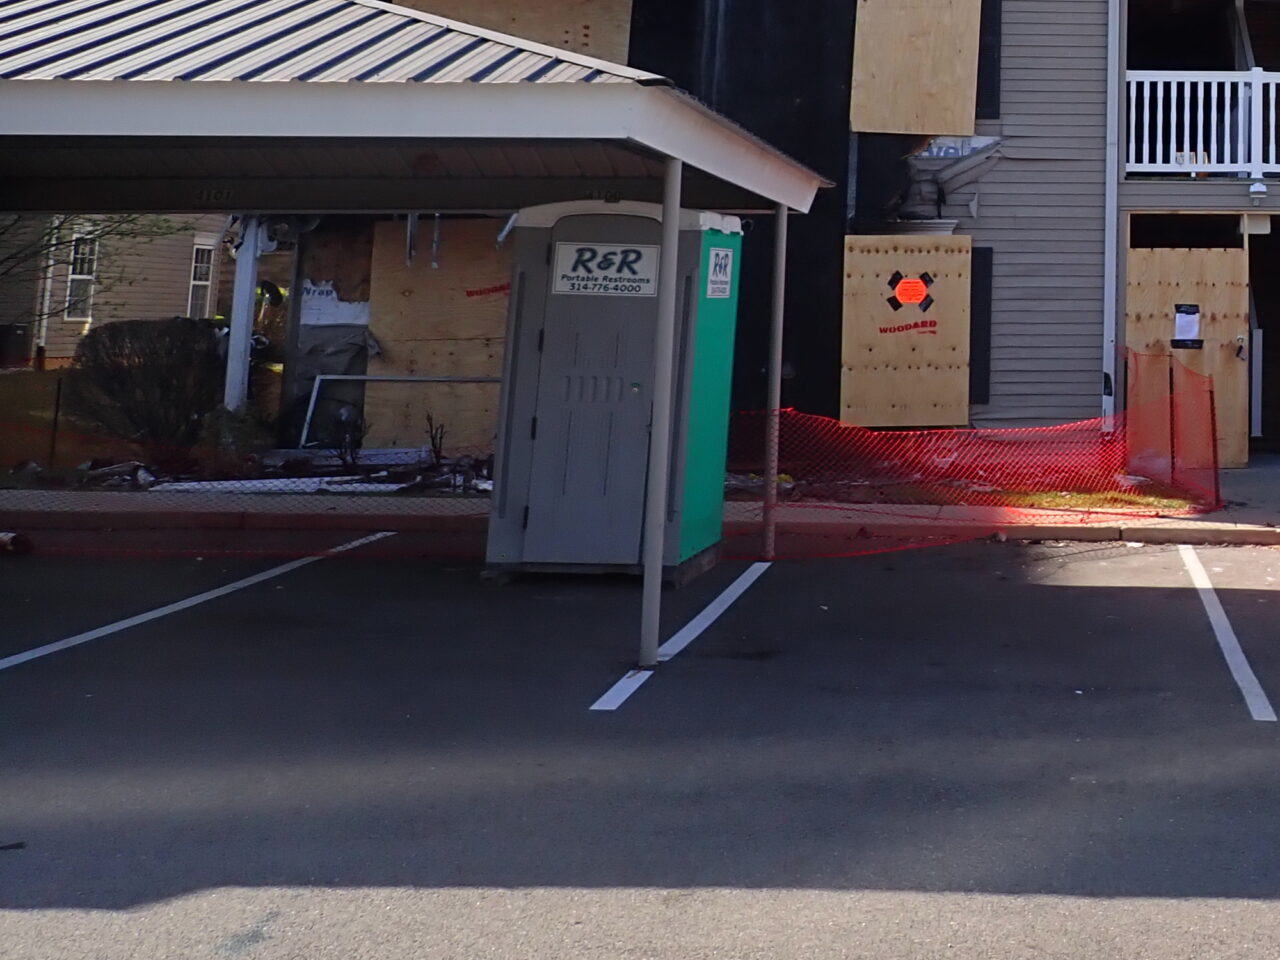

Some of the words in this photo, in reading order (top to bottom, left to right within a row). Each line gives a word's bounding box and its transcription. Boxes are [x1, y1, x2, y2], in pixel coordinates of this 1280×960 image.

[571, 247, 643, 276] R&R
[561, 274, 599, 283] Portable
[602, 275, 650, 284] Restrooms
[569, 283, 641, 293] 314-776-4000
[879, 320, 937, 334] WOODARD
